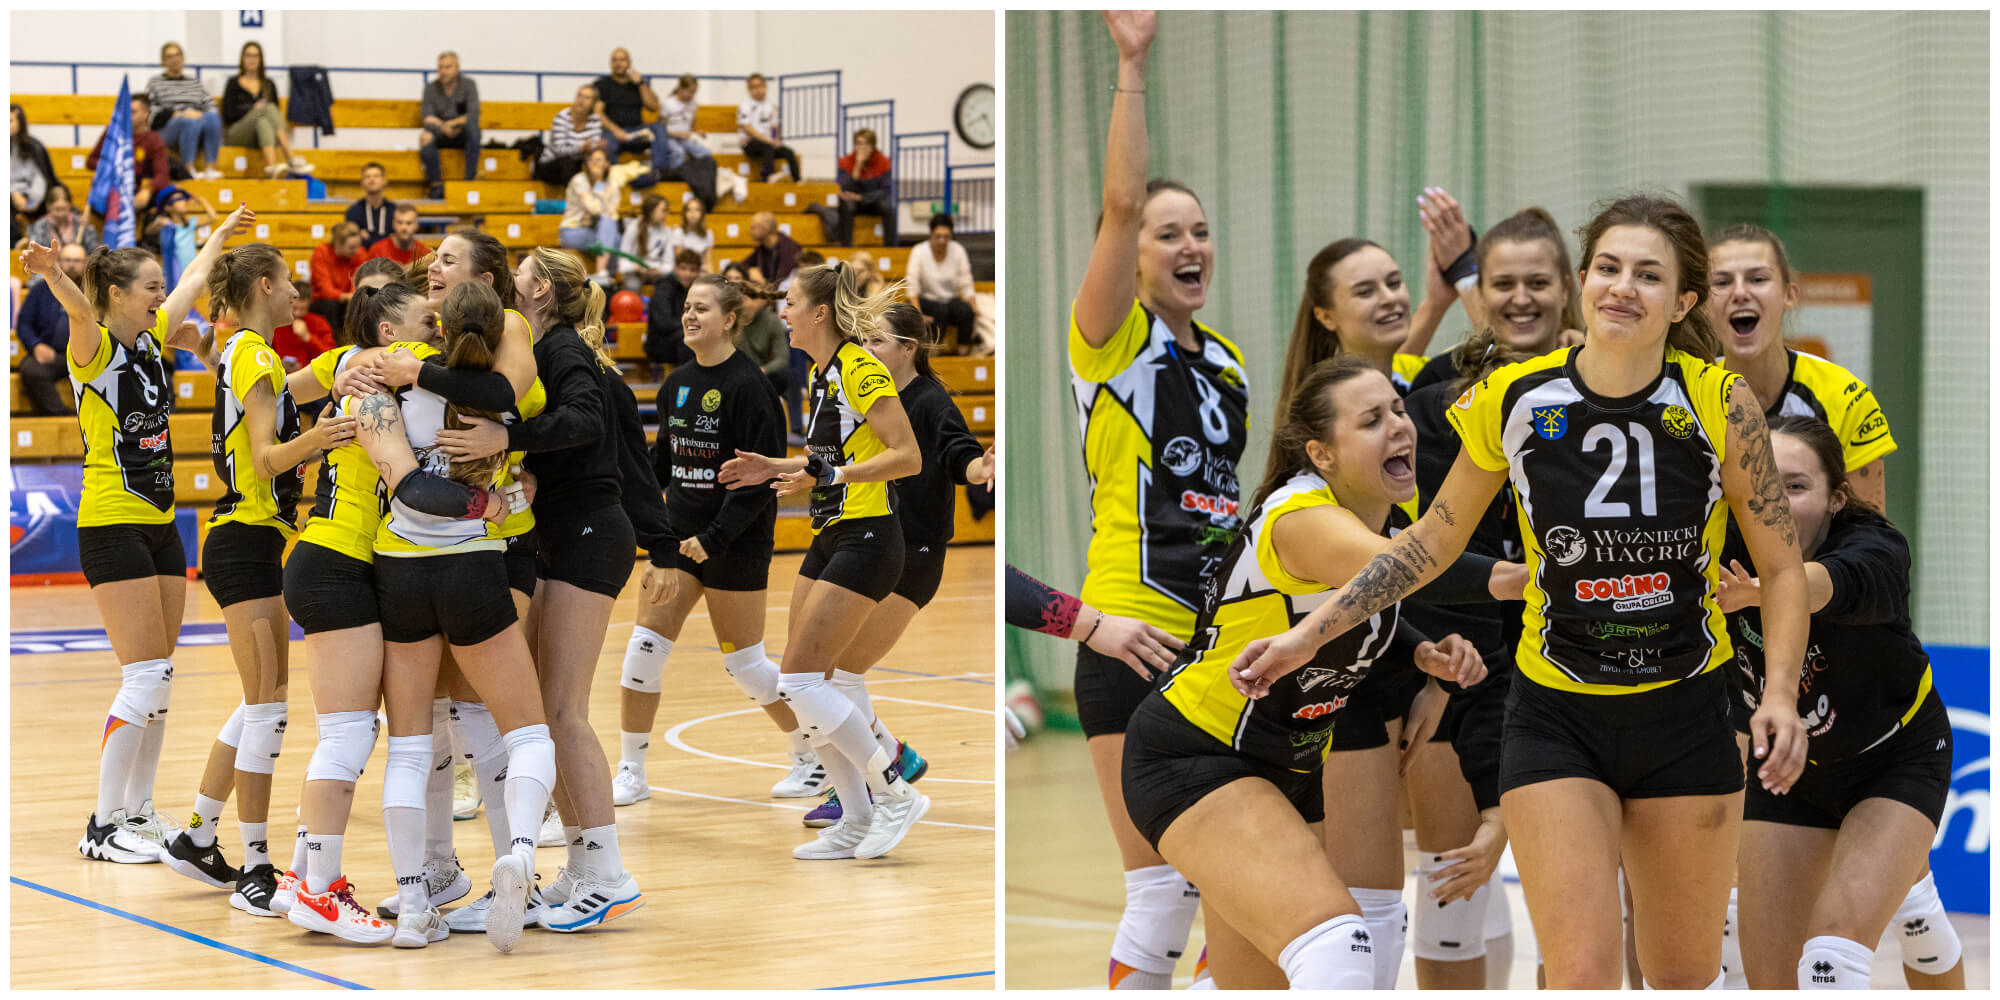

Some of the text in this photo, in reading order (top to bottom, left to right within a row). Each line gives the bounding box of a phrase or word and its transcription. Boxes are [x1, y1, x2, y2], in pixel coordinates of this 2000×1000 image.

[808, 389, 825, 439] 7
[1190, 367, 1230, 444] 8
[1582, 422, 1657, 518] 21
[1592, 526, 1697, 546] WOŹNIECKI
[1595, 541, 1697, 563] HAGRIC
